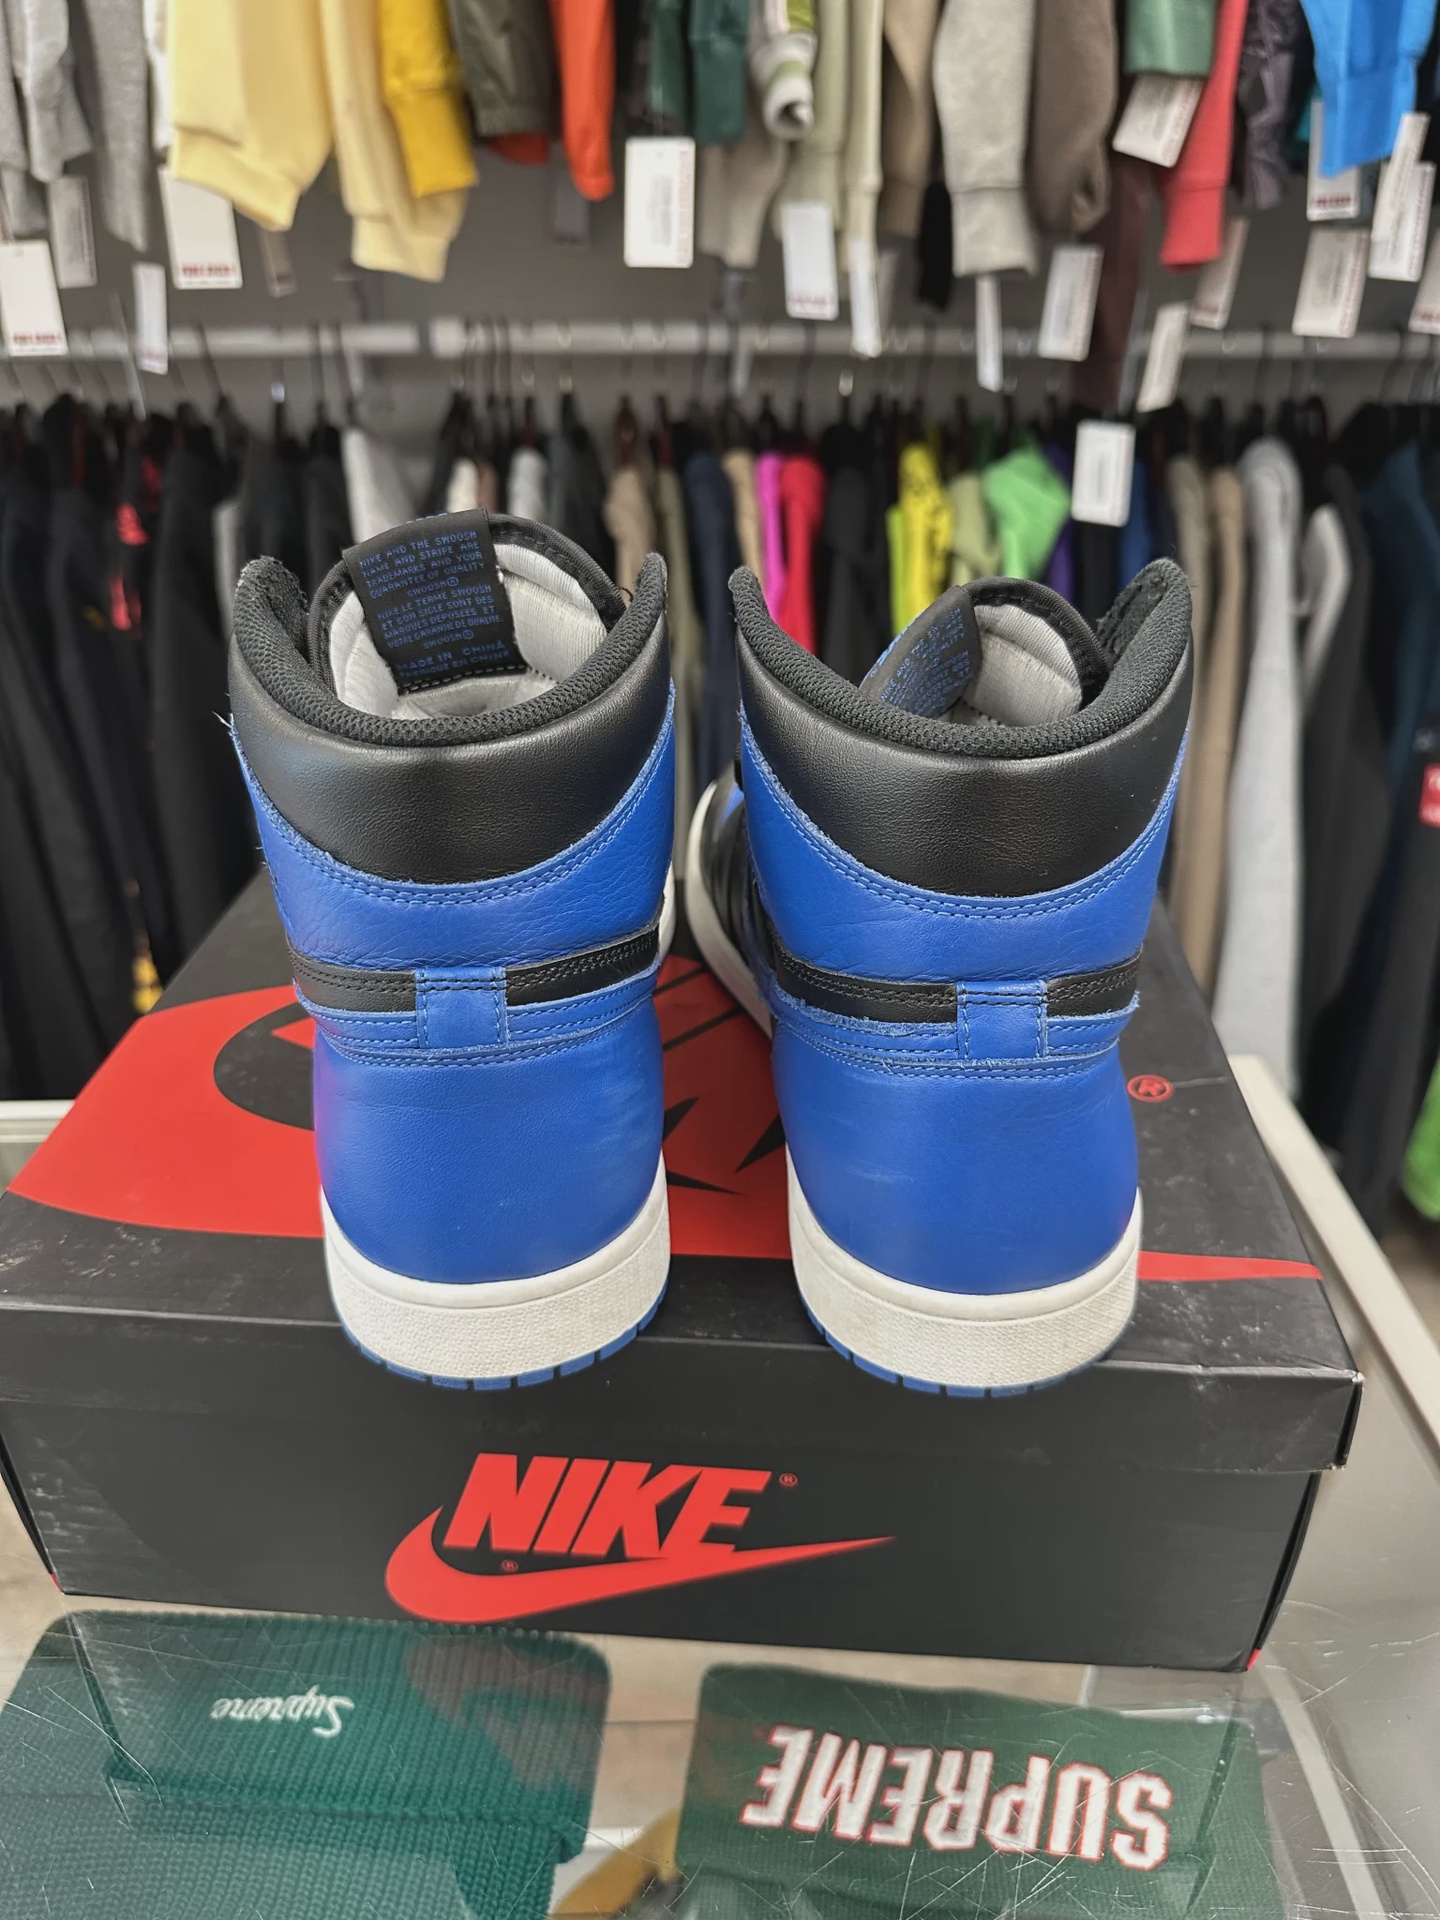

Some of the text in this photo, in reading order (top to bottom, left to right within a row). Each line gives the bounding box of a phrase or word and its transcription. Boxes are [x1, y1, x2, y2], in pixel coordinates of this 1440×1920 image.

[360, 531, 477, 568] NIKE AND THE SWOOSH
[363, 542, 480, 578] NAME AND STRIPE ARE
[366, 552, 482, 588] TRADEMARKS AND YOUR
[370, 561, 484, 599] GUARANTEE OF QUALITY
[382, 620, 393, 630] ET
[396, 612, 416, 624] SON
[446, 598, 472, 609] SONT
[476, 596, 494, 604] DES
[416, 592, 448, 606] TERME
[452, 585, 492, 598] SWOOSH
[384, 619, 428, 640] MARQUES
[484, 606, 494, 614] ET
[388, 635, 413, 648] VOTRE
[455, 620, 466, 628] DE
[396, 640, 505, 670] MADE IN CHINA
[210, 1684, 355, 1739] Supreme
[740, 1722, 1173, 1871] SUPREME
